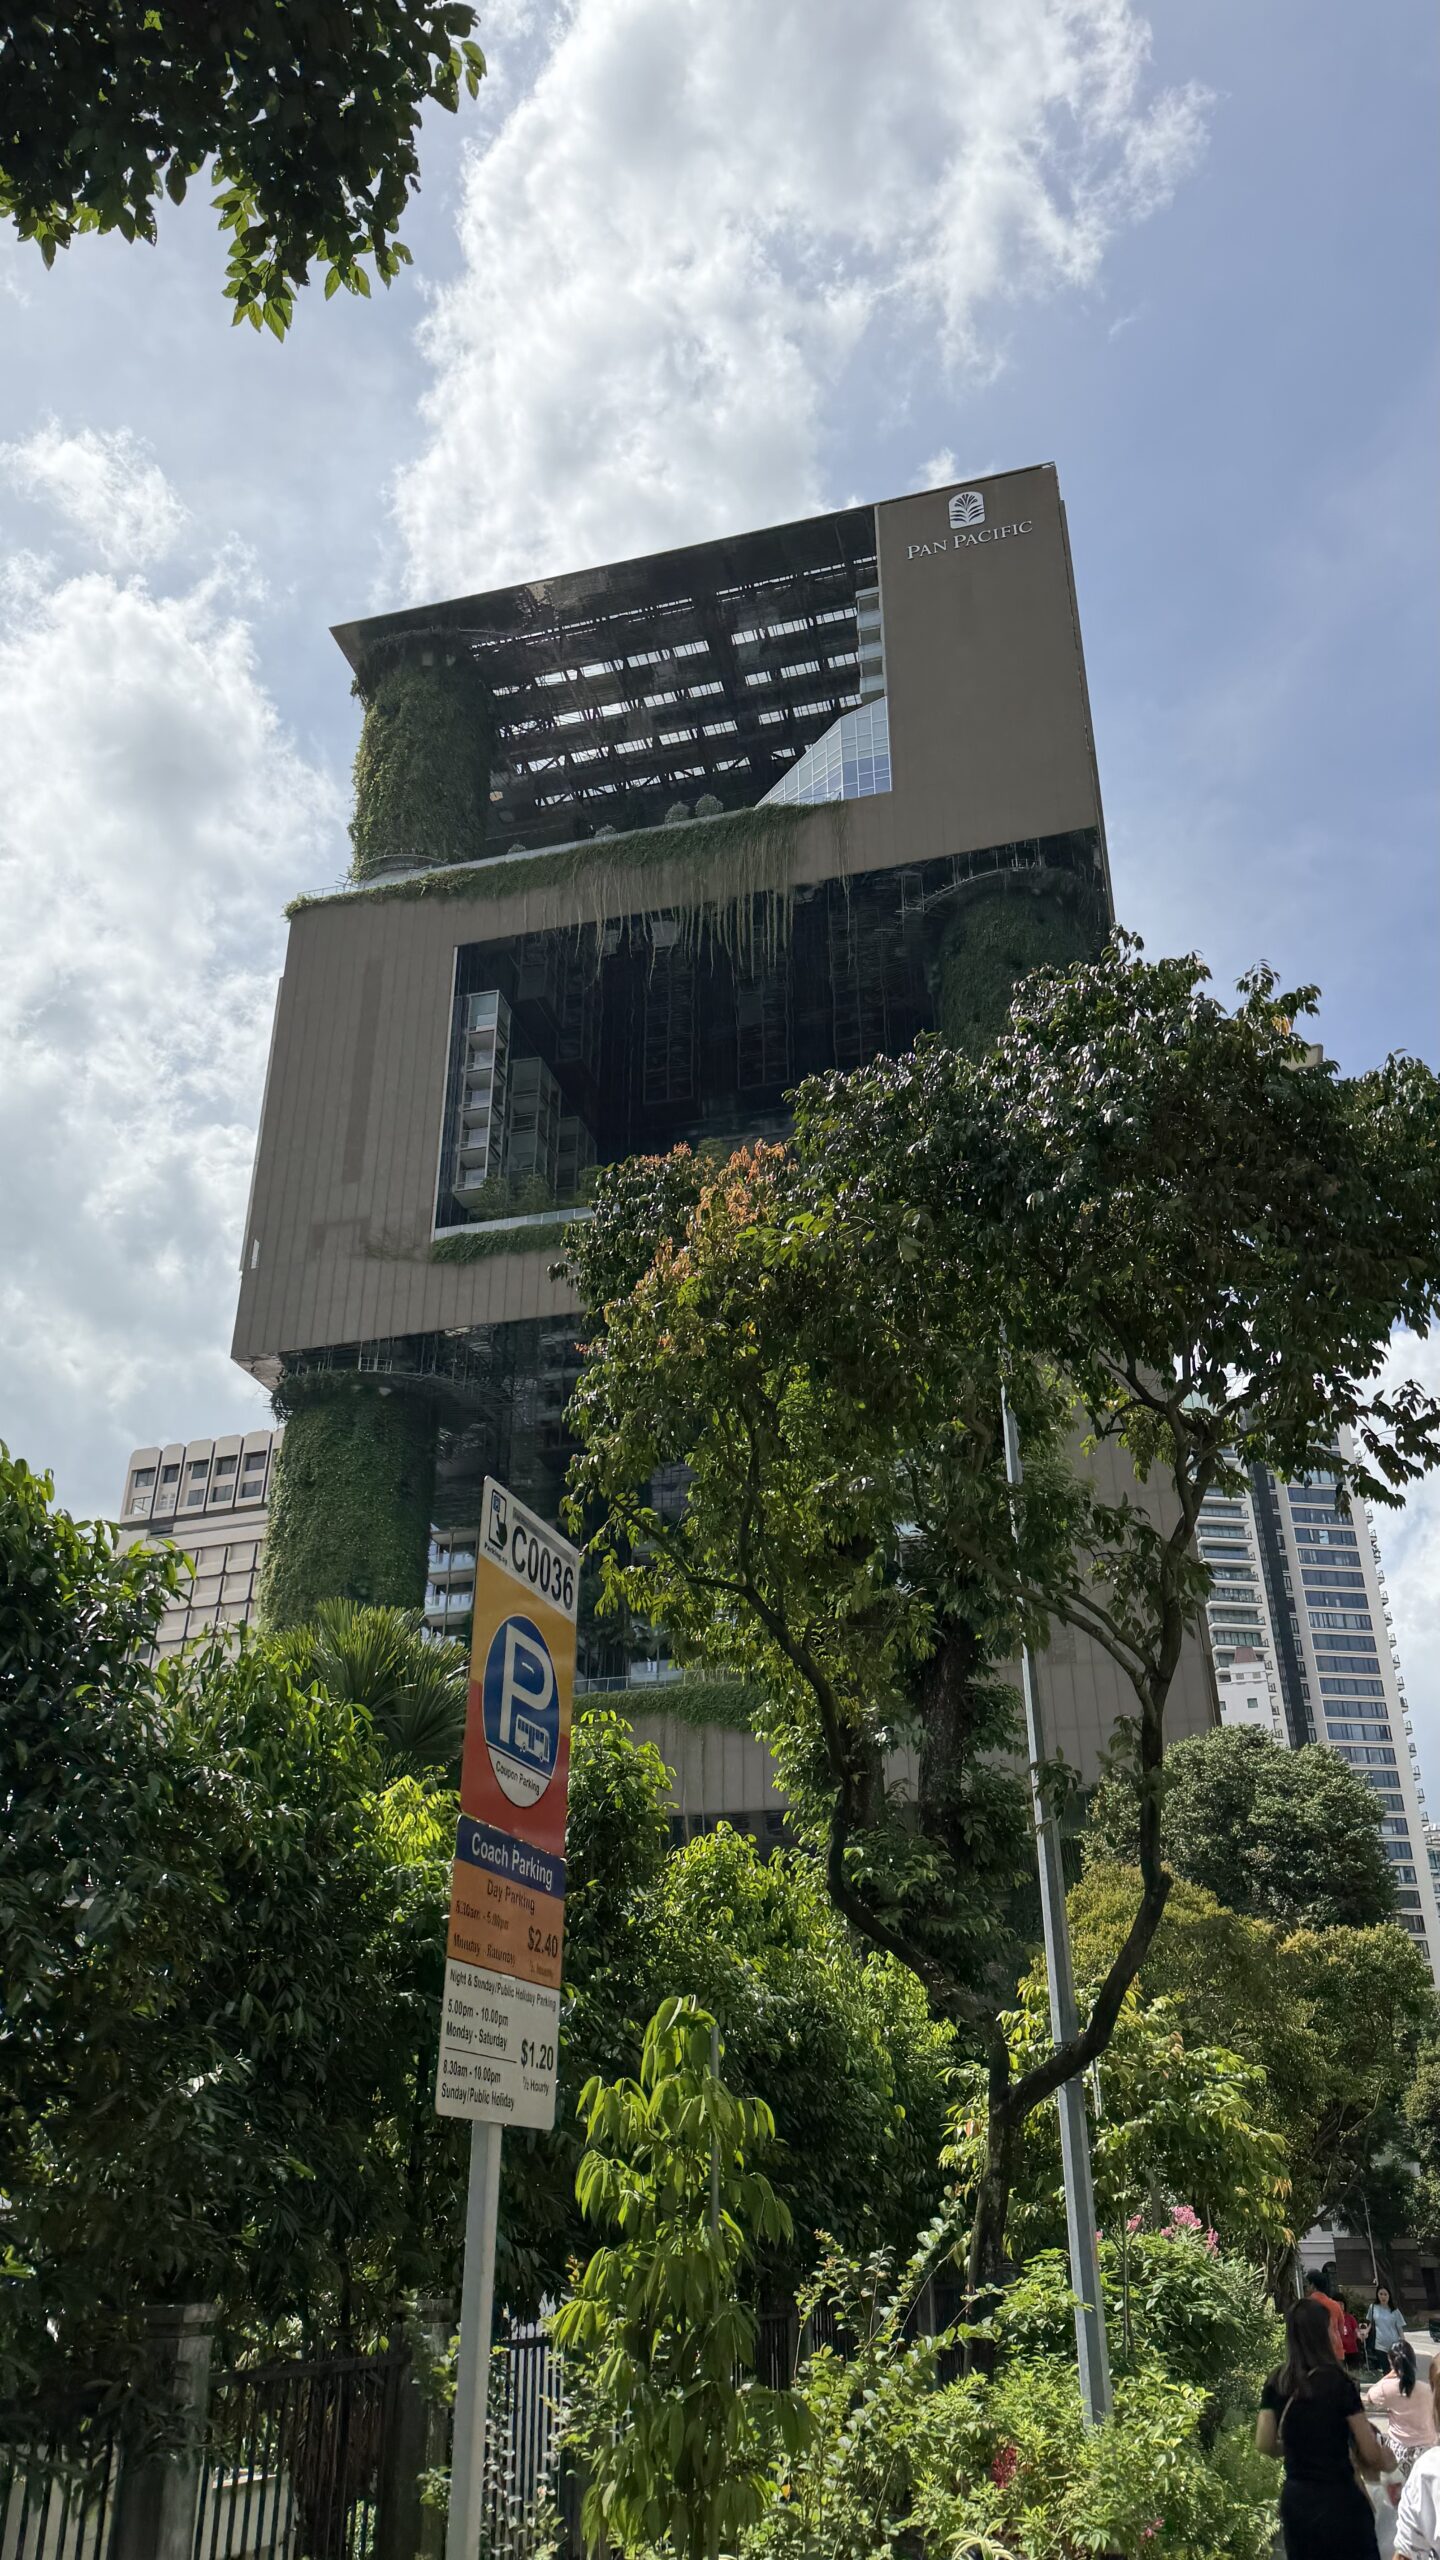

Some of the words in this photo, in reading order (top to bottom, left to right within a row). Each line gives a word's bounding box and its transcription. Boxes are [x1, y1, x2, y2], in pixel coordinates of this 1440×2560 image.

[907, 539, 948, 560] PAN
[954, 520, 1033, 549] PACIFIC
[512, 1525, 574, 1611] C0036
[499, 1622, 554, 1745] P
[495, 1760, 518, 1784] Coupon
[519, 1774, 540, 1796] Parking
[472, 1832, 508, 1869] Coach
[511, 1849, 553, 1891] Parking
[487, 1879, 503, 1902] Day
[505, 1885, 535, 1916] Parking
[528, 1925, 558, 1959] $2.40
[450, 1969, 467, 1986] Night
[467, 1973, 473, 1987] &
[515, 1987, 535, 2007] Holiday
[536, 1993, 556, 2012] Parking
[447, 1999, 474, 2018] 5.00pm
[481, 2007, 509, 2028] 10.00pm
[446, 2020, 474, 2044] Monday
[479, 2029, 507, 2051] Saturday
[443, 2059, 468, 2077] 8.30am
[474, 2065, 501, 2086] 10.00pm
[521, 2038, 554, 2072] $1.20
[491, 2090, 514, 2111] Holiday
[530, 2079, 549, 2096] Hourly
